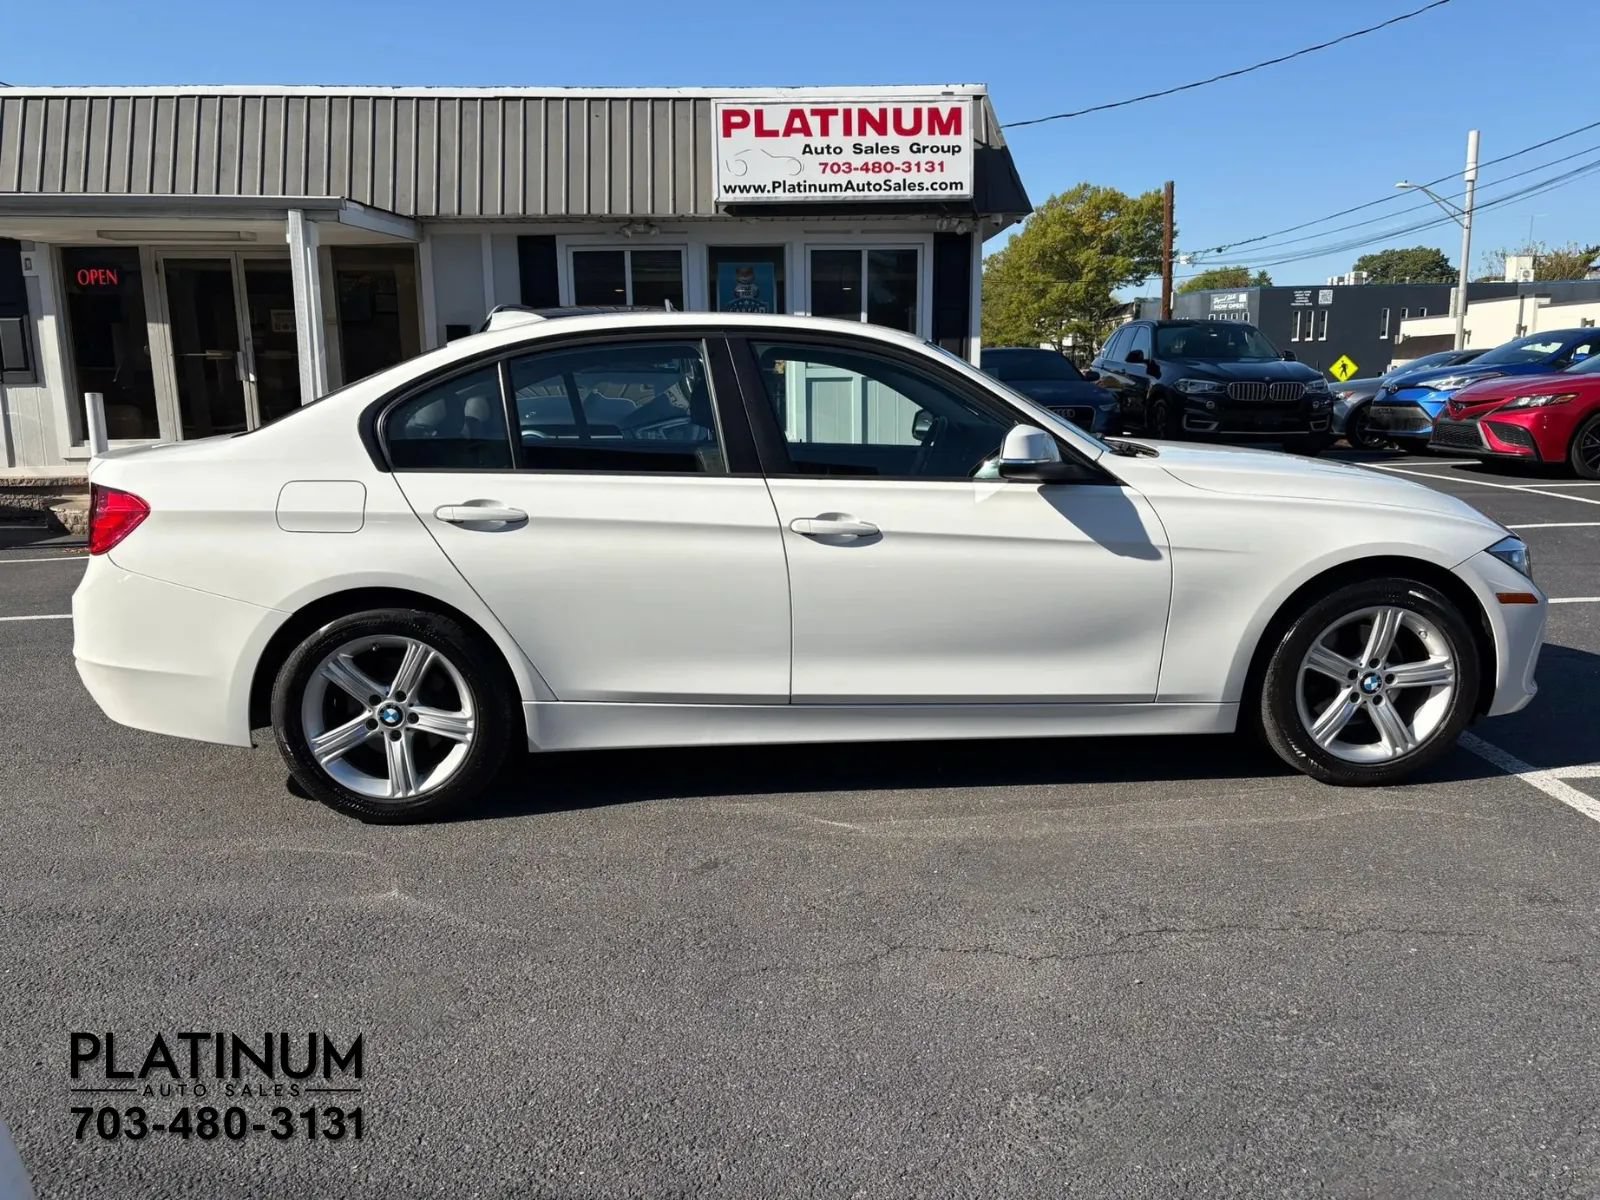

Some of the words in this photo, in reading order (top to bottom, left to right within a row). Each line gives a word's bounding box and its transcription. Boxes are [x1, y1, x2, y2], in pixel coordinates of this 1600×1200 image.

[722, 107, 962, 138] PLATINUM
[802, 144, 843, 155] Auto
[852, 143, 900, 155] Sales
[909, 142, 962, 156] Group
[818, 161, 945, 174] 703-480-3131
[723, 178, 964, 194] www.PlatinumAutoSales.com
[77, 268, 118, 285] OPEN
